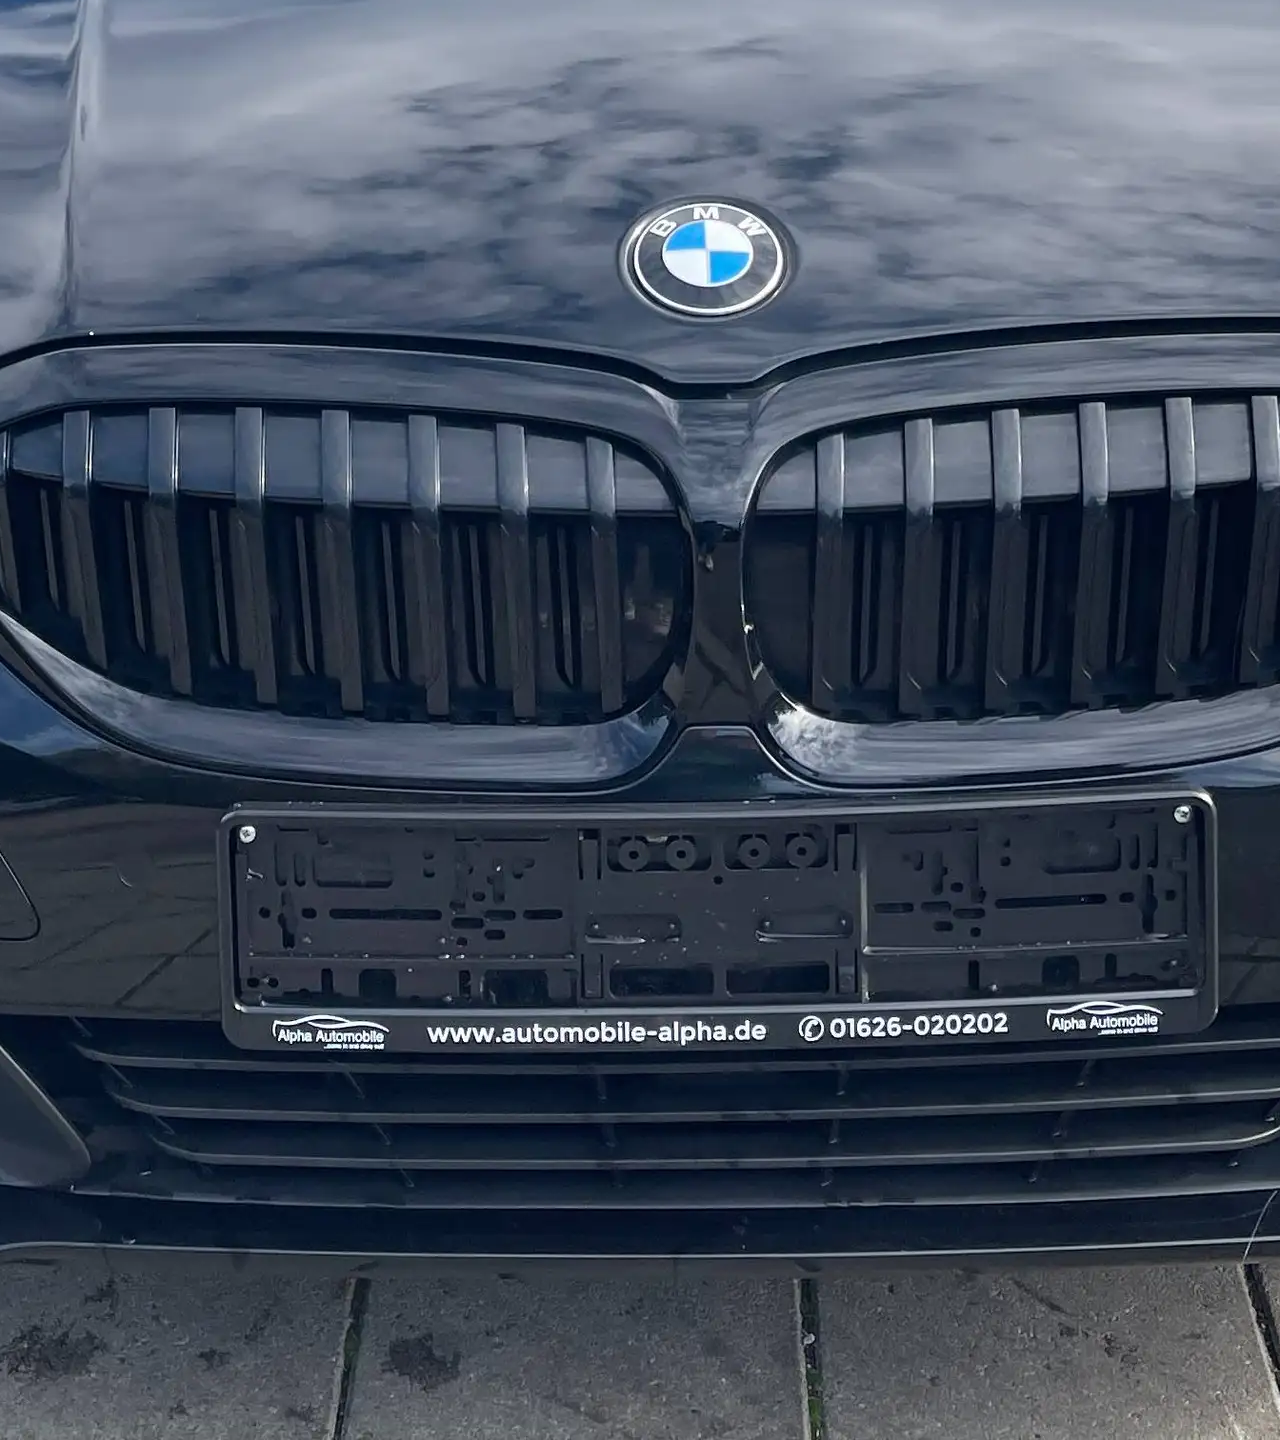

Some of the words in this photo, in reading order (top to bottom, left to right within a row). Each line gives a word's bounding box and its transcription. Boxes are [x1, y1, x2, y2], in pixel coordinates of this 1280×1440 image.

[650, 206, 768, 238] BMW
[426, 1019, 767, 1046] www.automobile-alpha.de
[829, 1012, 1009, 1038] 01626-020202
[1052, 1017, 1087, 1033] Alpha
[1089, 1013, 1158, 1029] Automobile
[277, 1029, 312, 1044] Alpha
[316, 1029, 385, 1043] Automobile
